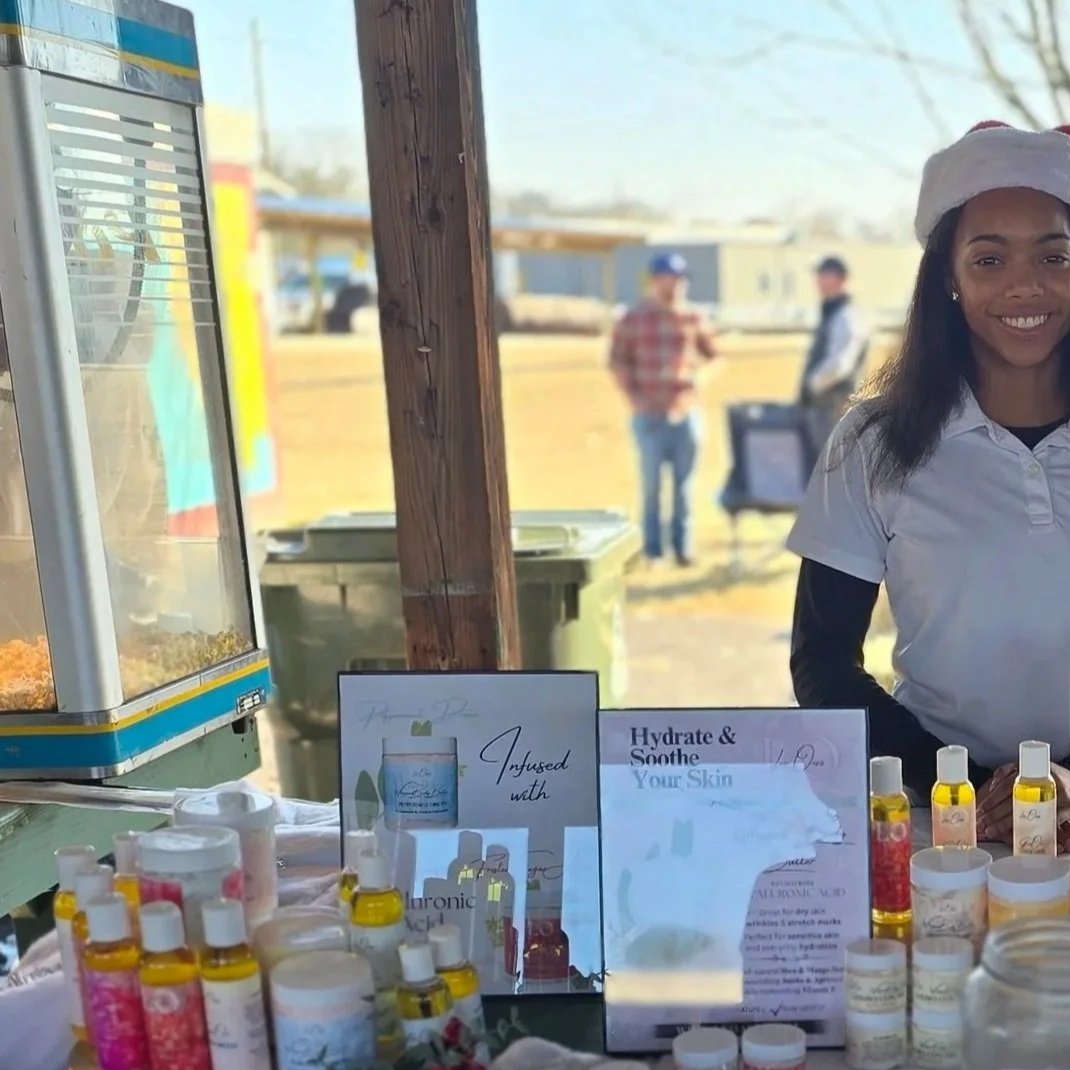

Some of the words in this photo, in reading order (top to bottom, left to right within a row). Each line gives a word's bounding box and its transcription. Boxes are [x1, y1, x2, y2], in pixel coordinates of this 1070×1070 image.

[630, 726, 714, 750] Hydrate
[718, 725, 736, 745] &
[480, 726, 571, 785] Infused
[630, 748, 700, 766] Soothe
[633, 769, 682, 790] Your
[686, 768, 733, 790] Skin
[510, 779, 550, 802] with
[404, 891, 476, 910] luronic
